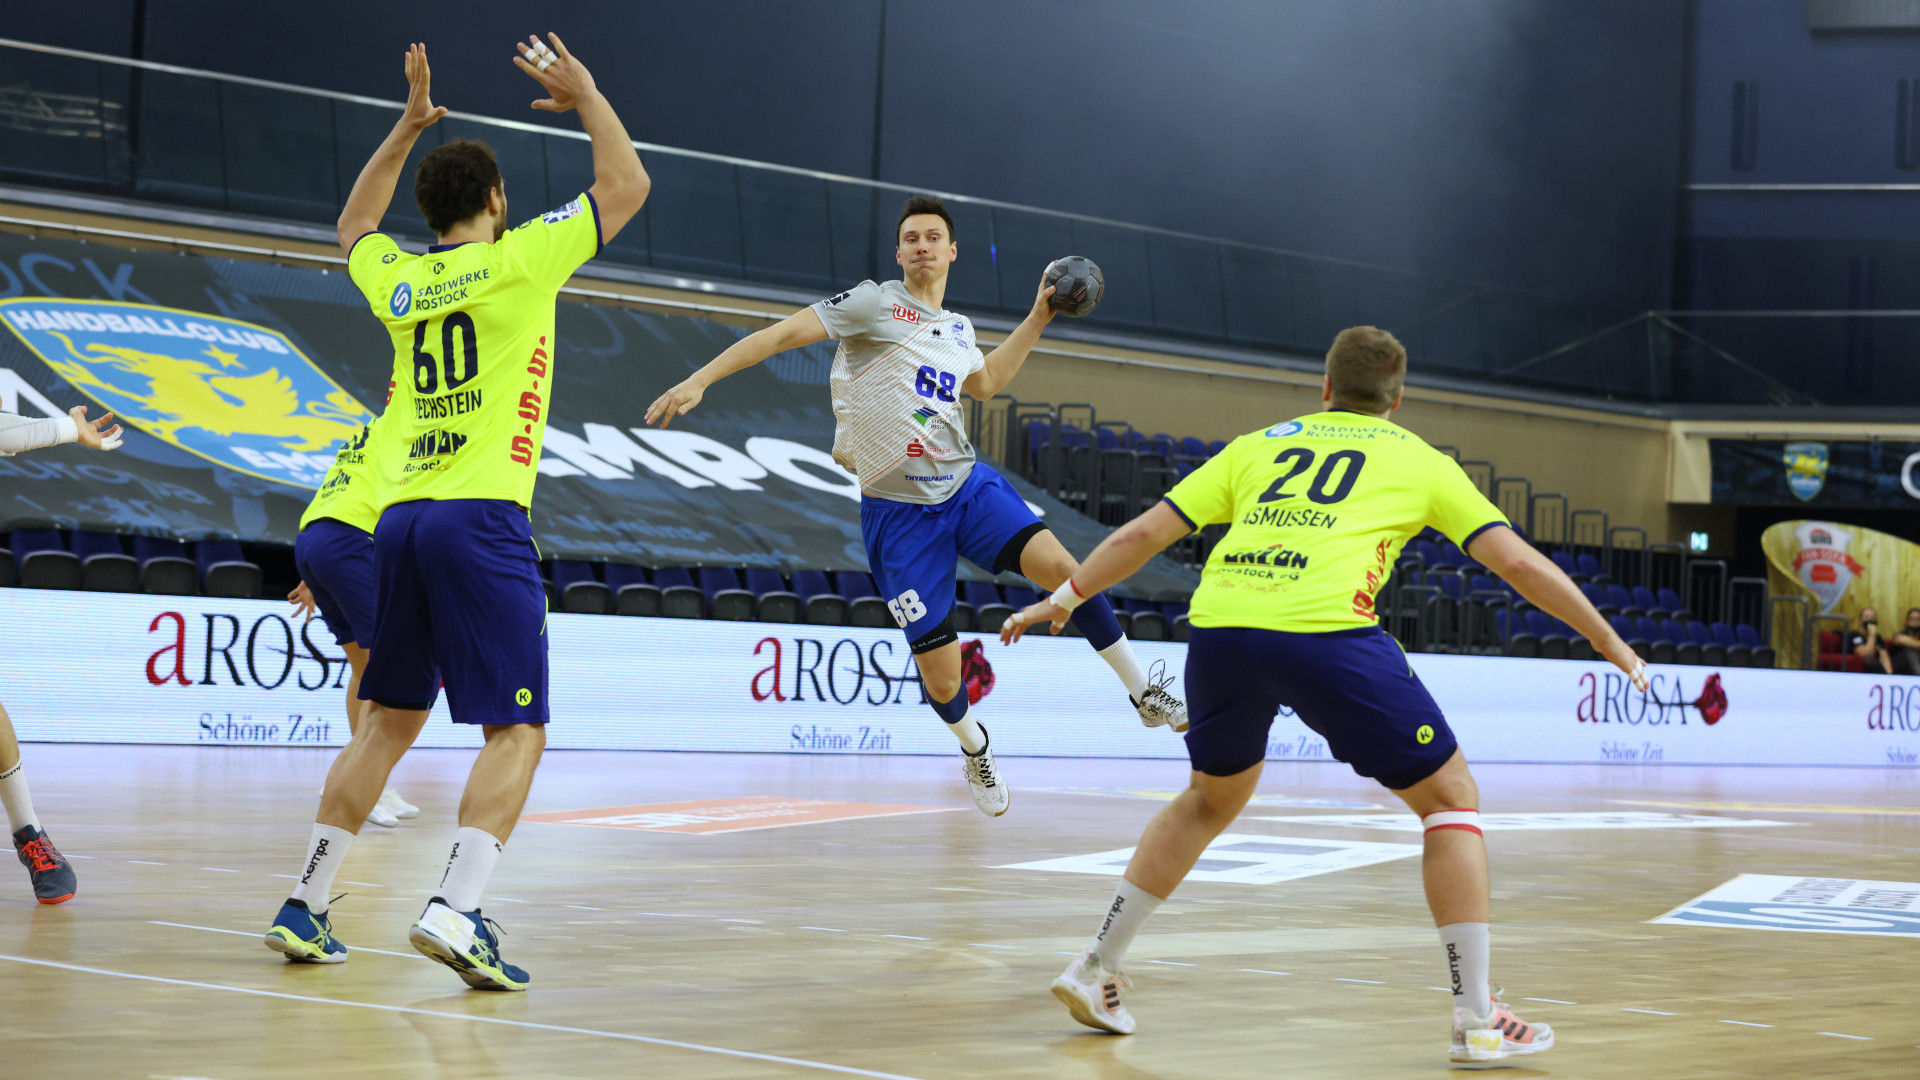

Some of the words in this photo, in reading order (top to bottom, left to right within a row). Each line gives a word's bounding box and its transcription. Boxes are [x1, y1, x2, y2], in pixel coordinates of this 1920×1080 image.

[415, 287, 469, 311] ROSTOCK
[416, 268, 490, 298] SADTWERKE
[6, 310, 289, 355] HANDBALLCLUB
[413, 311, 478, 394] 60
[915, 365, 956, 402] 68
[1311, 424, 1408, 440] STADTWERKE
[229, 446, 336, 472] EMP
[1257, 448, 1366, 504] 20
[888, 589, 927, 628] 68
[199, 713, 280, 742] Schöne
[287, 714, 332, 742] Zeit
[790, 724, 853, 750] Schöne
[858, 726, 893, 750] Zeit
[300, 838, 330, 885] Kempa
[1446, 943, 1464, 996] Kempa
